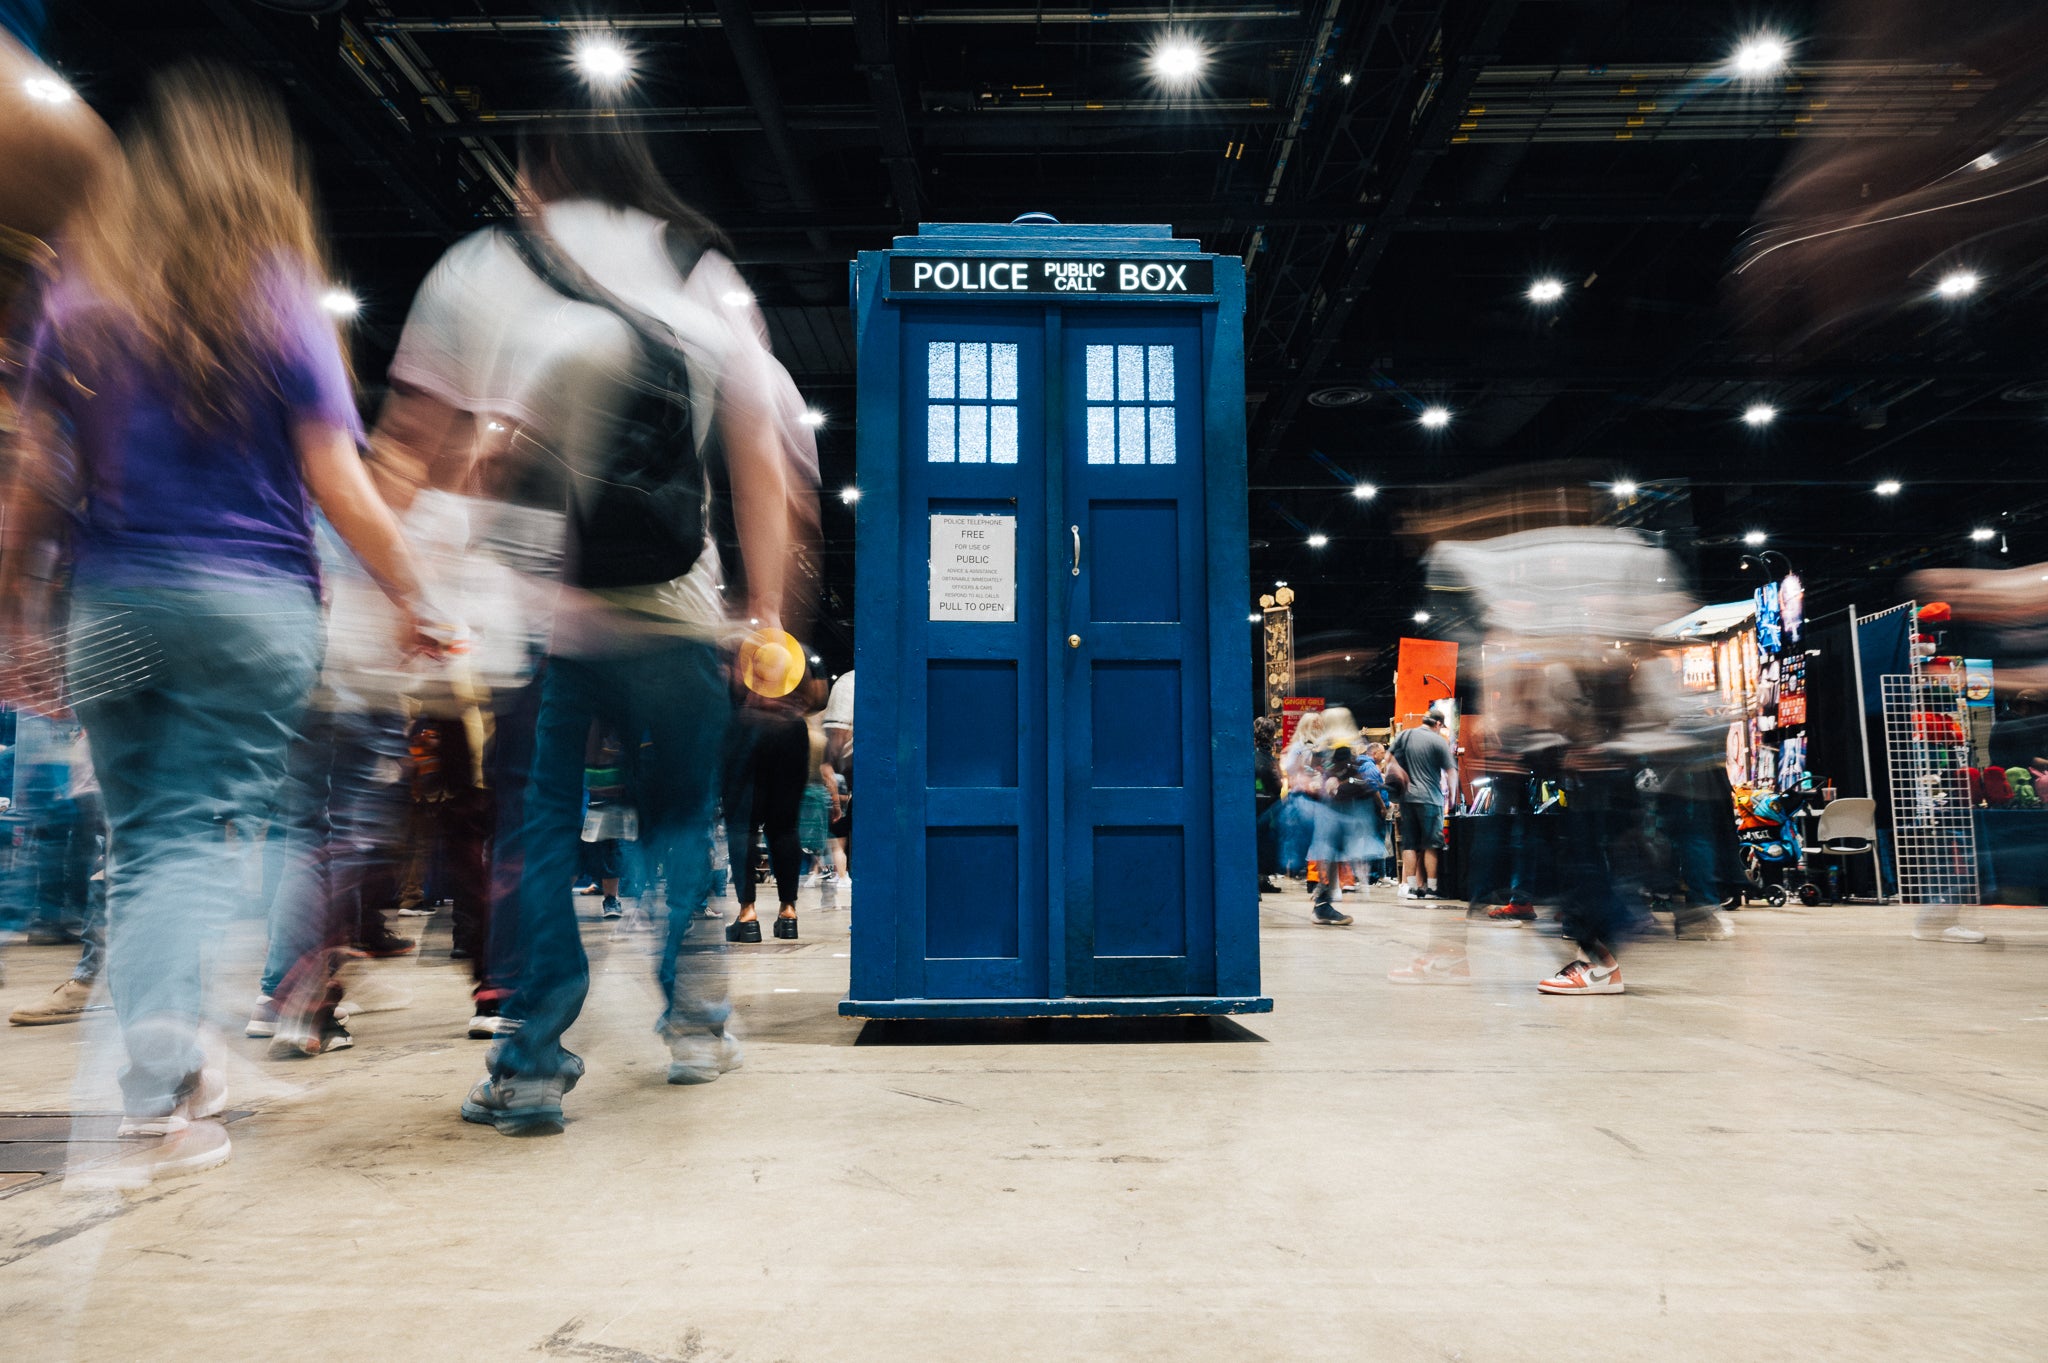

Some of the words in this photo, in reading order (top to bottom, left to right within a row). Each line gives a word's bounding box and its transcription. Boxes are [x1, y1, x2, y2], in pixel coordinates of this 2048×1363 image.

[914, 262, 1028, 290] POLICE
[1044, 262, 1105, 278] PUBLIC
[1119, 263, 1187, 291] BOX
[1054, 277, 1097, 291] CALL
[961, 530, 985, 539] FREE
[956, 555, 989, 564] PUBLIC
[939, 602, 962, 611] PULL
[965, 603, 977, 611] TO
[978, 603, 1005, 612] OPEN
